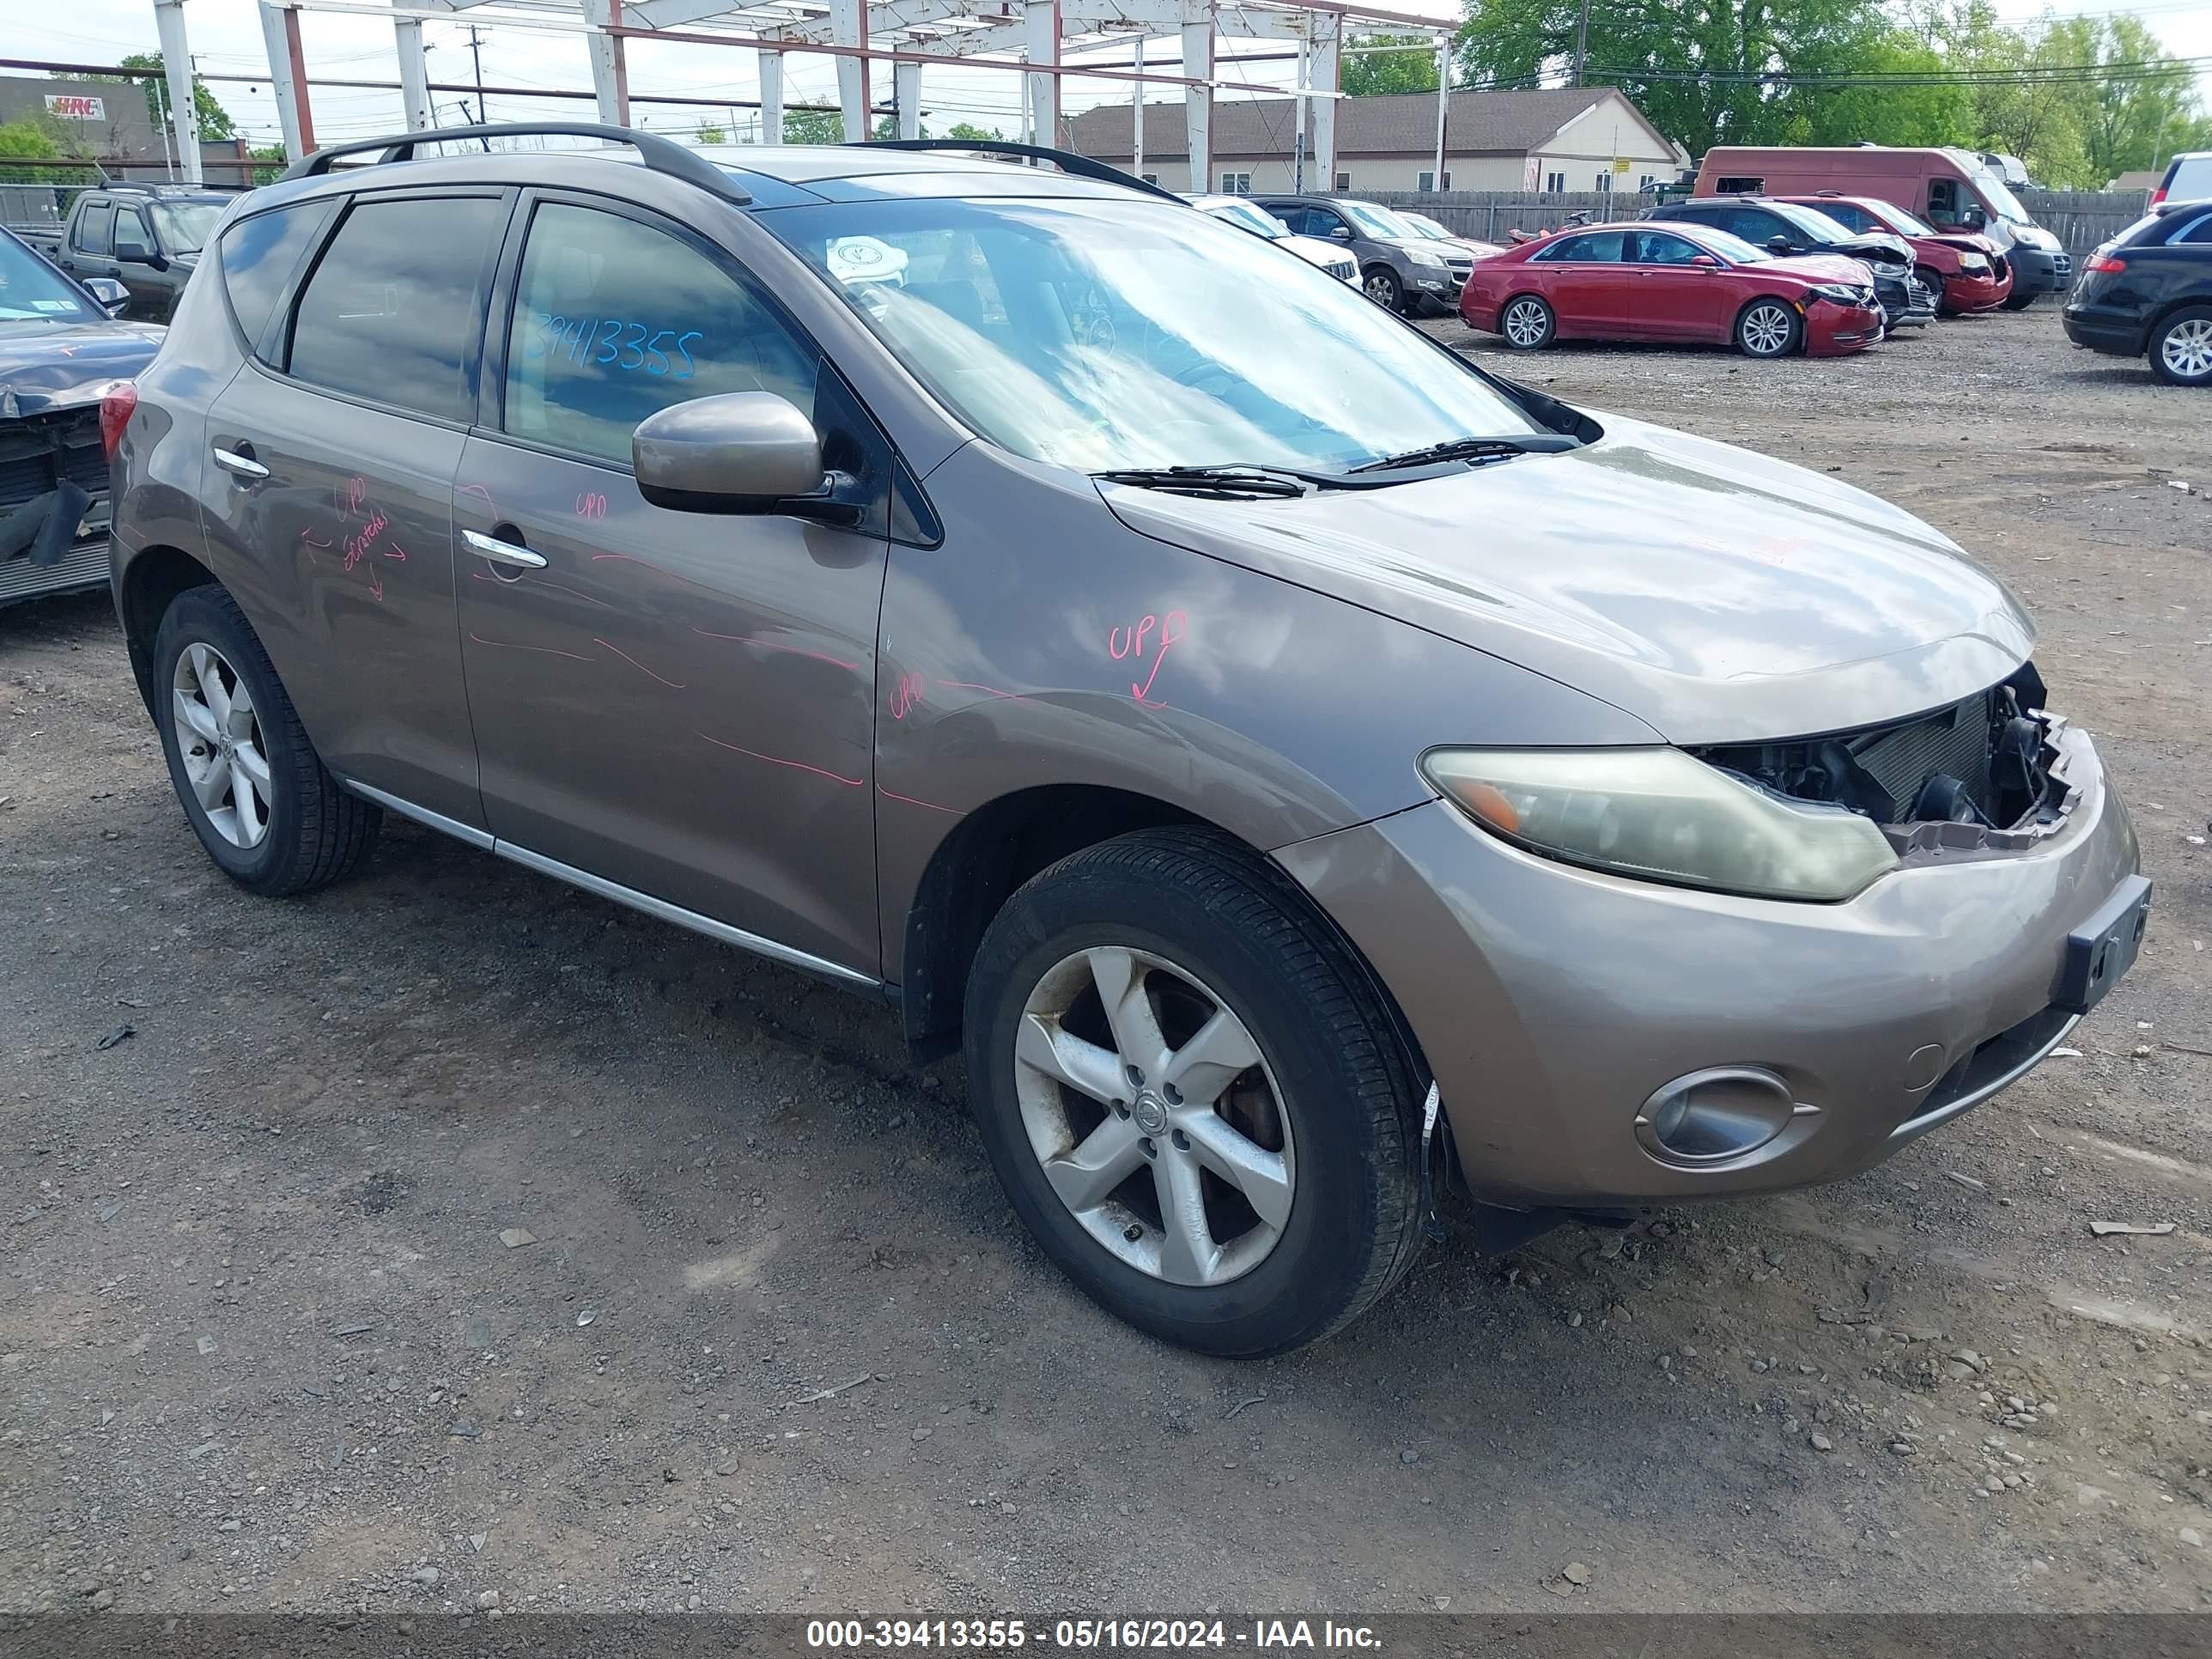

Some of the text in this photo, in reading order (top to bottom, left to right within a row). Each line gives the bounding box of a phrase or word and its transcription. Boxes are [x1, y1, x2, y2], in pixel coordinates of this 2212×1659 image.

[527, 313, 702, 379] 39413355
[334, 477, 366, 523] UPD
[576, 492, 606, 520] UPD
[1109, 611, 1188, 659] UPD
